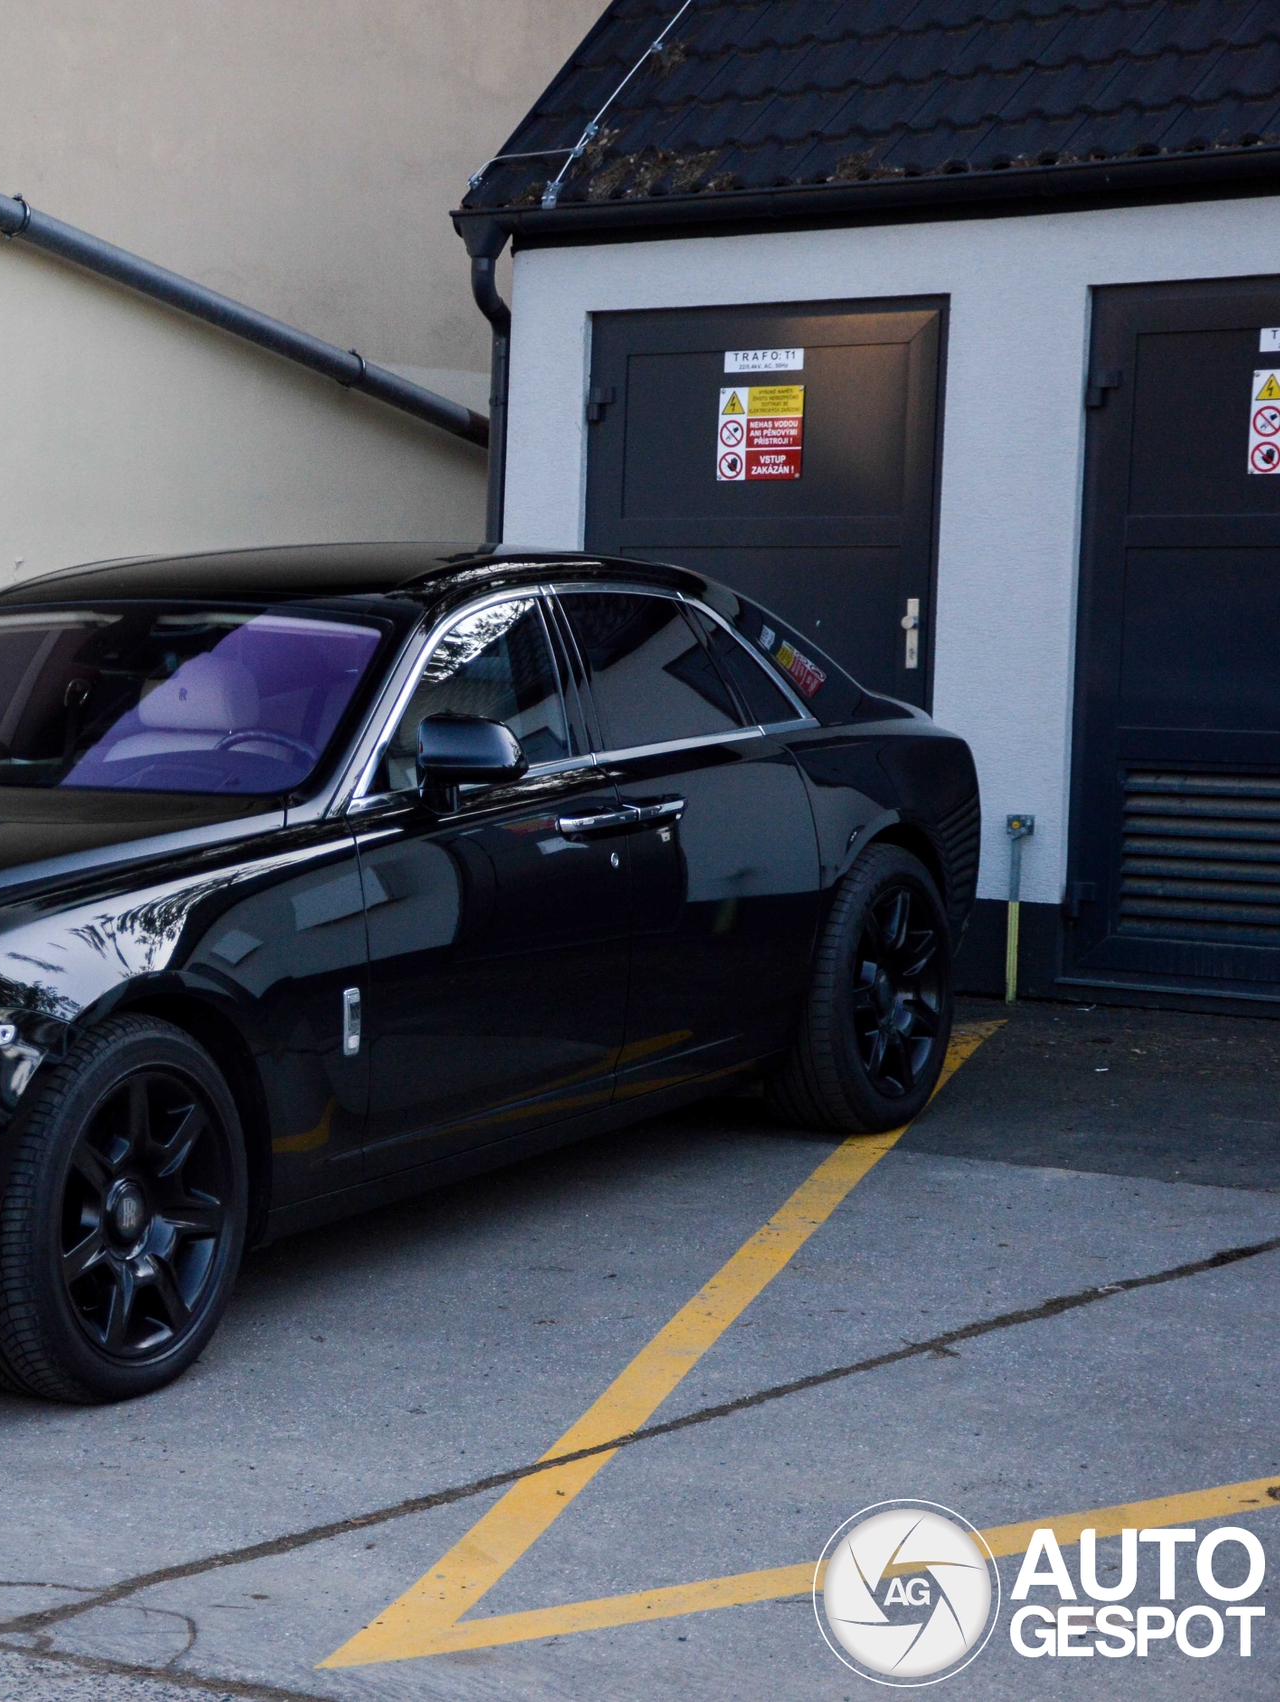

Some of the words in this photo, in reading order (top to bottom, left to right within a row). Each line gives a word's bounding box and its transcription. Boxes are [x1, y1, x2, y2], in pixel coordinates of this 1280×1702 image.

[785, 350, 796, 360] T1
[759, 455, 787, 463] VSTUP
[751, 464, 790, 475] ZAKÁZÁN
